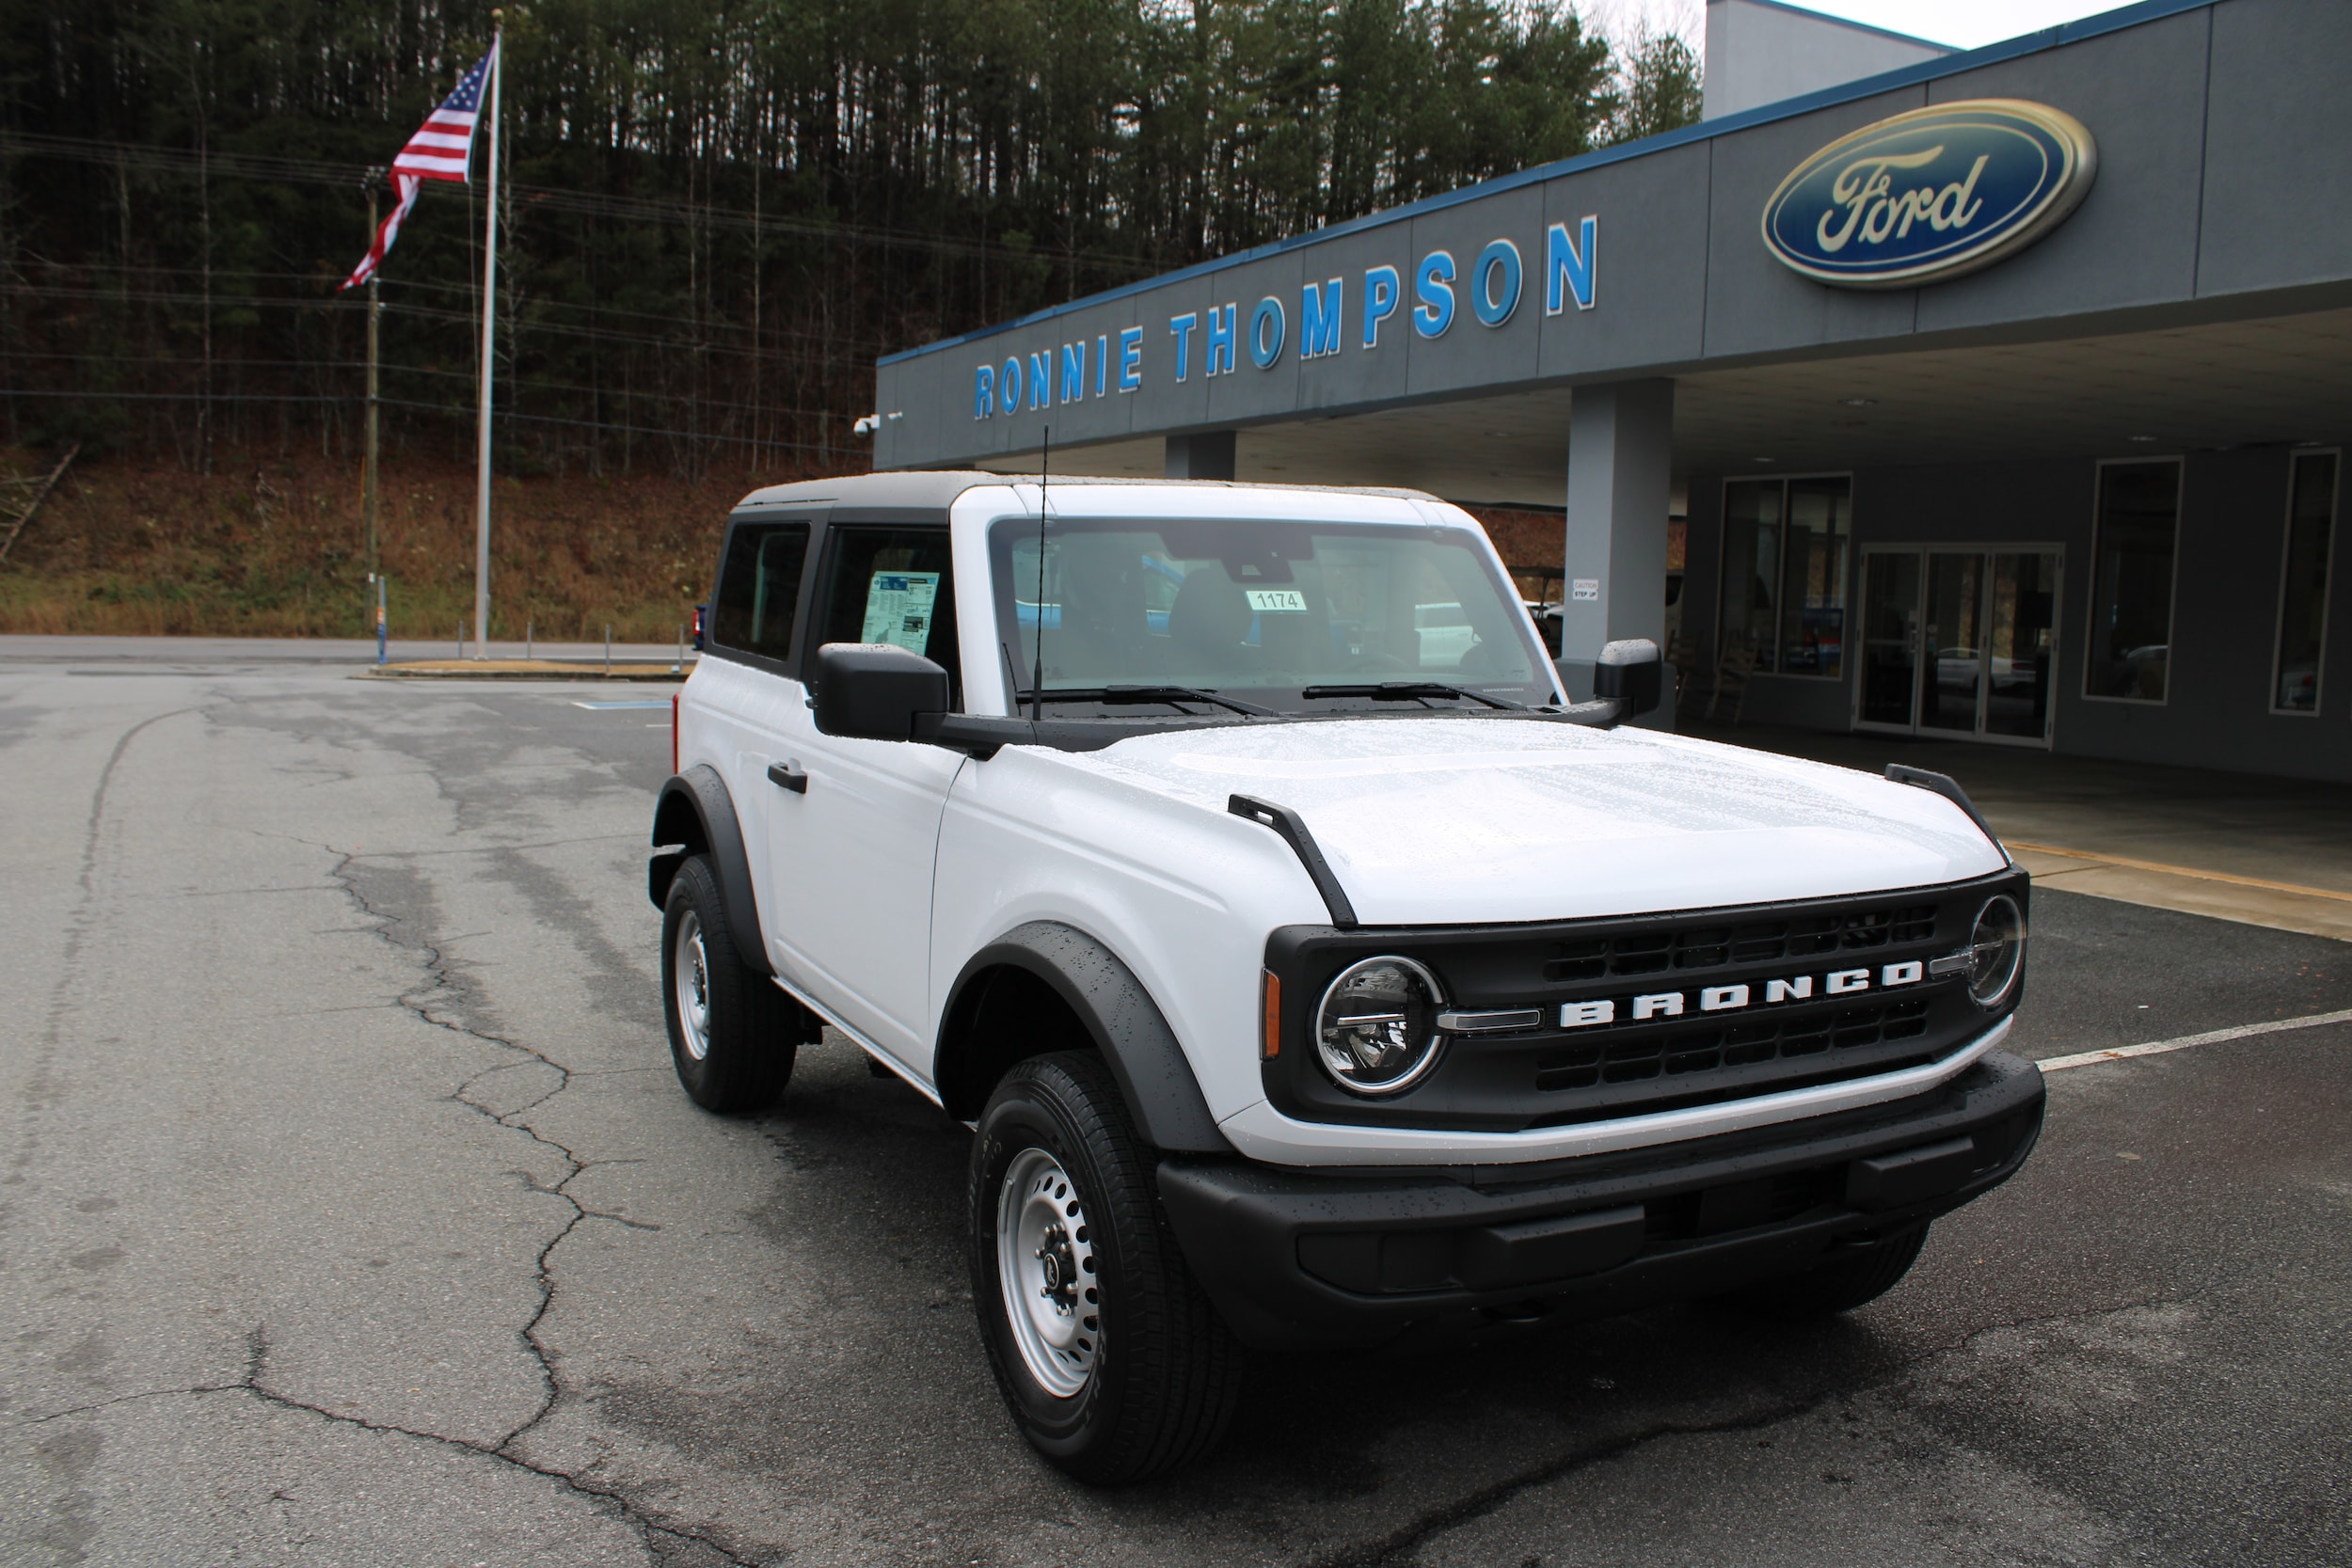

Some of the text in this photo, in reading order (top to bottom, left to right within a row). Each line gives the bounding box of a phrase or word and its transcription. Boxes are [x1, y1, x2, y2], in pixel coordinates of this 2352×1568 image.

[1817, 145, 1990, 252] Ford
[975, 214, 1598, 420] RONNIE THOMPSON
[1257, 593, 1298, 609] 1174
[1560, 960, 1924, 1028] BRONCO
